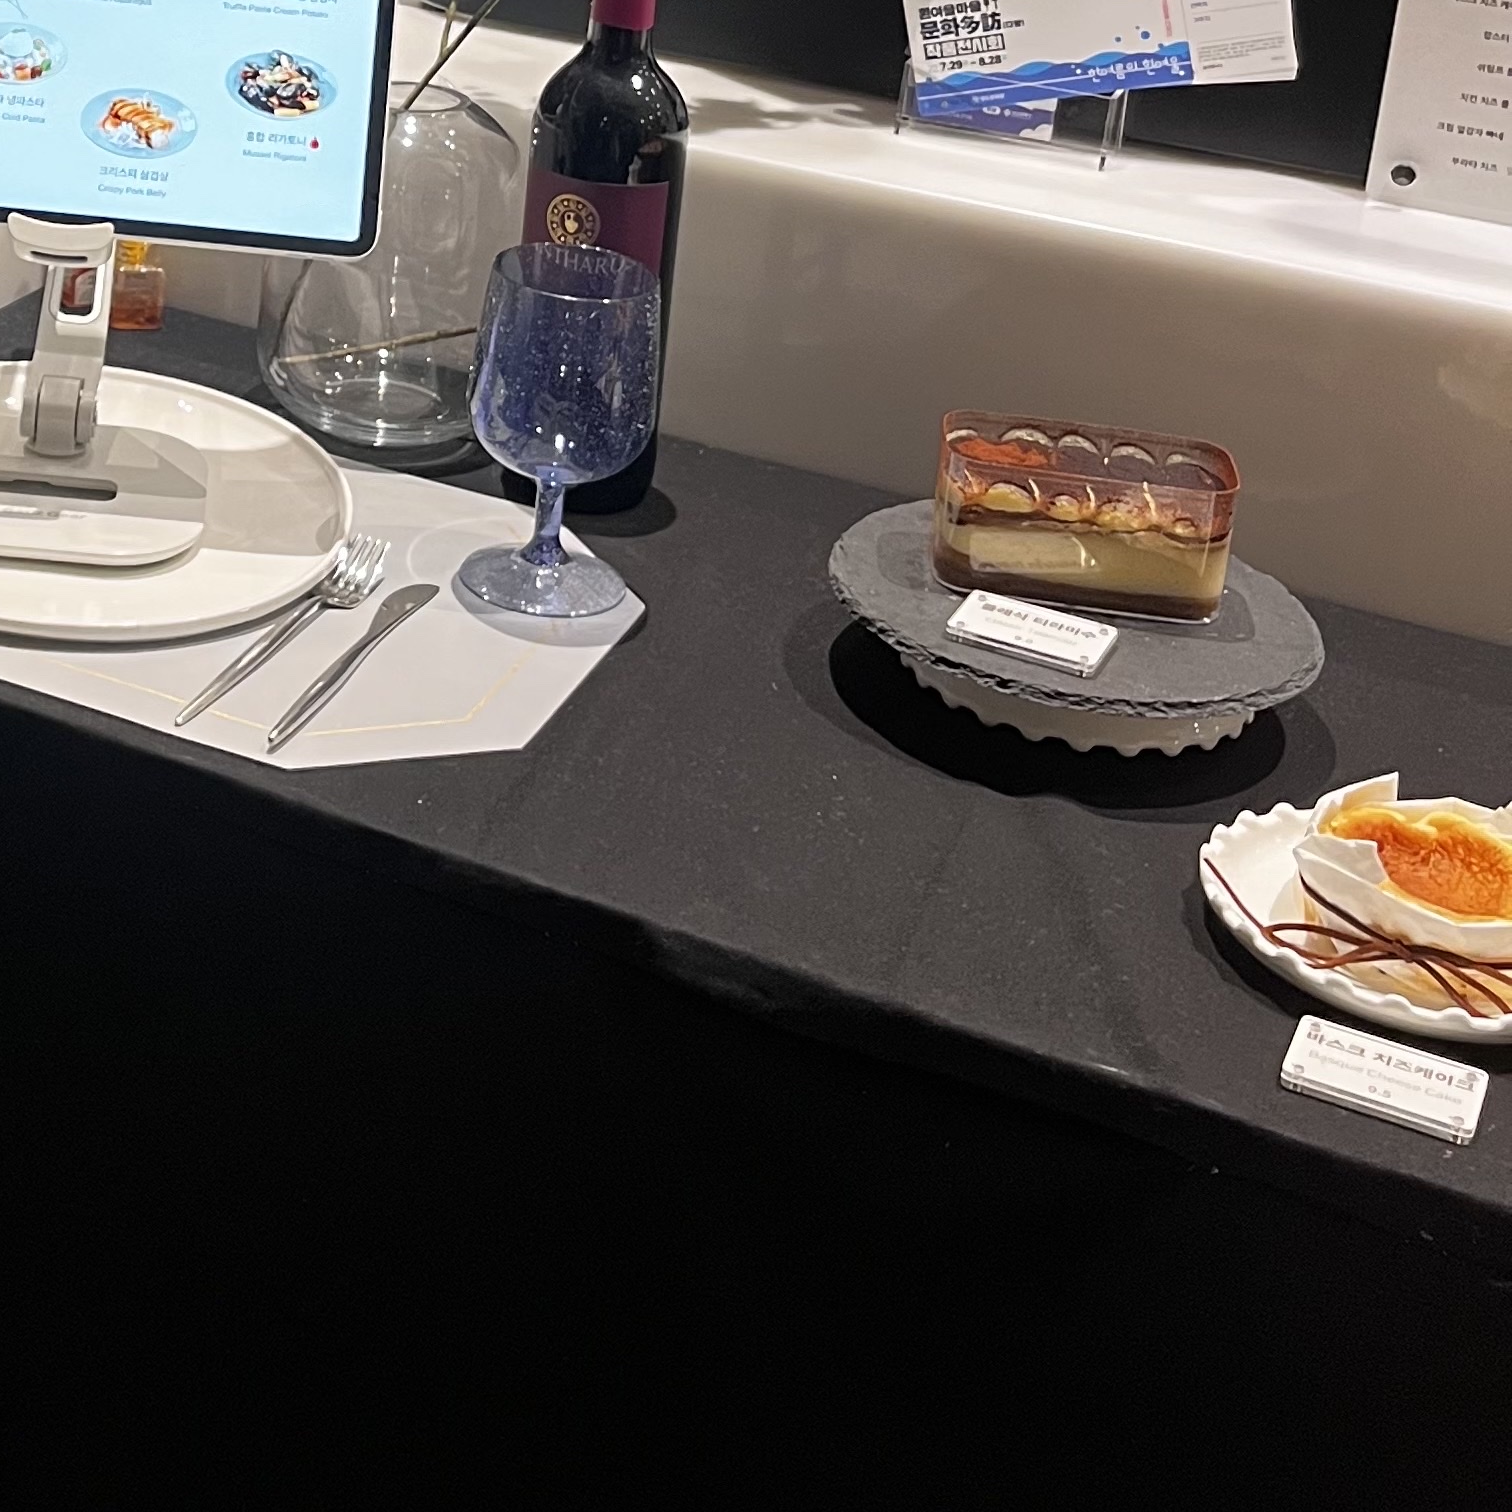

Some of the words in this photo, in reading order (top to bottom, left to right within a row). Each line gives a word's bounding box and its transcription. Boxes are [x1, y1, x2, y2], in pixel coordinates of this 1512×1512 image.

[99, 166, 138, 179] 크리스피
[1306, 1031, 1365, 1058] 바스크
[1372, 1051, 1475, 1092] 치즈케이크
